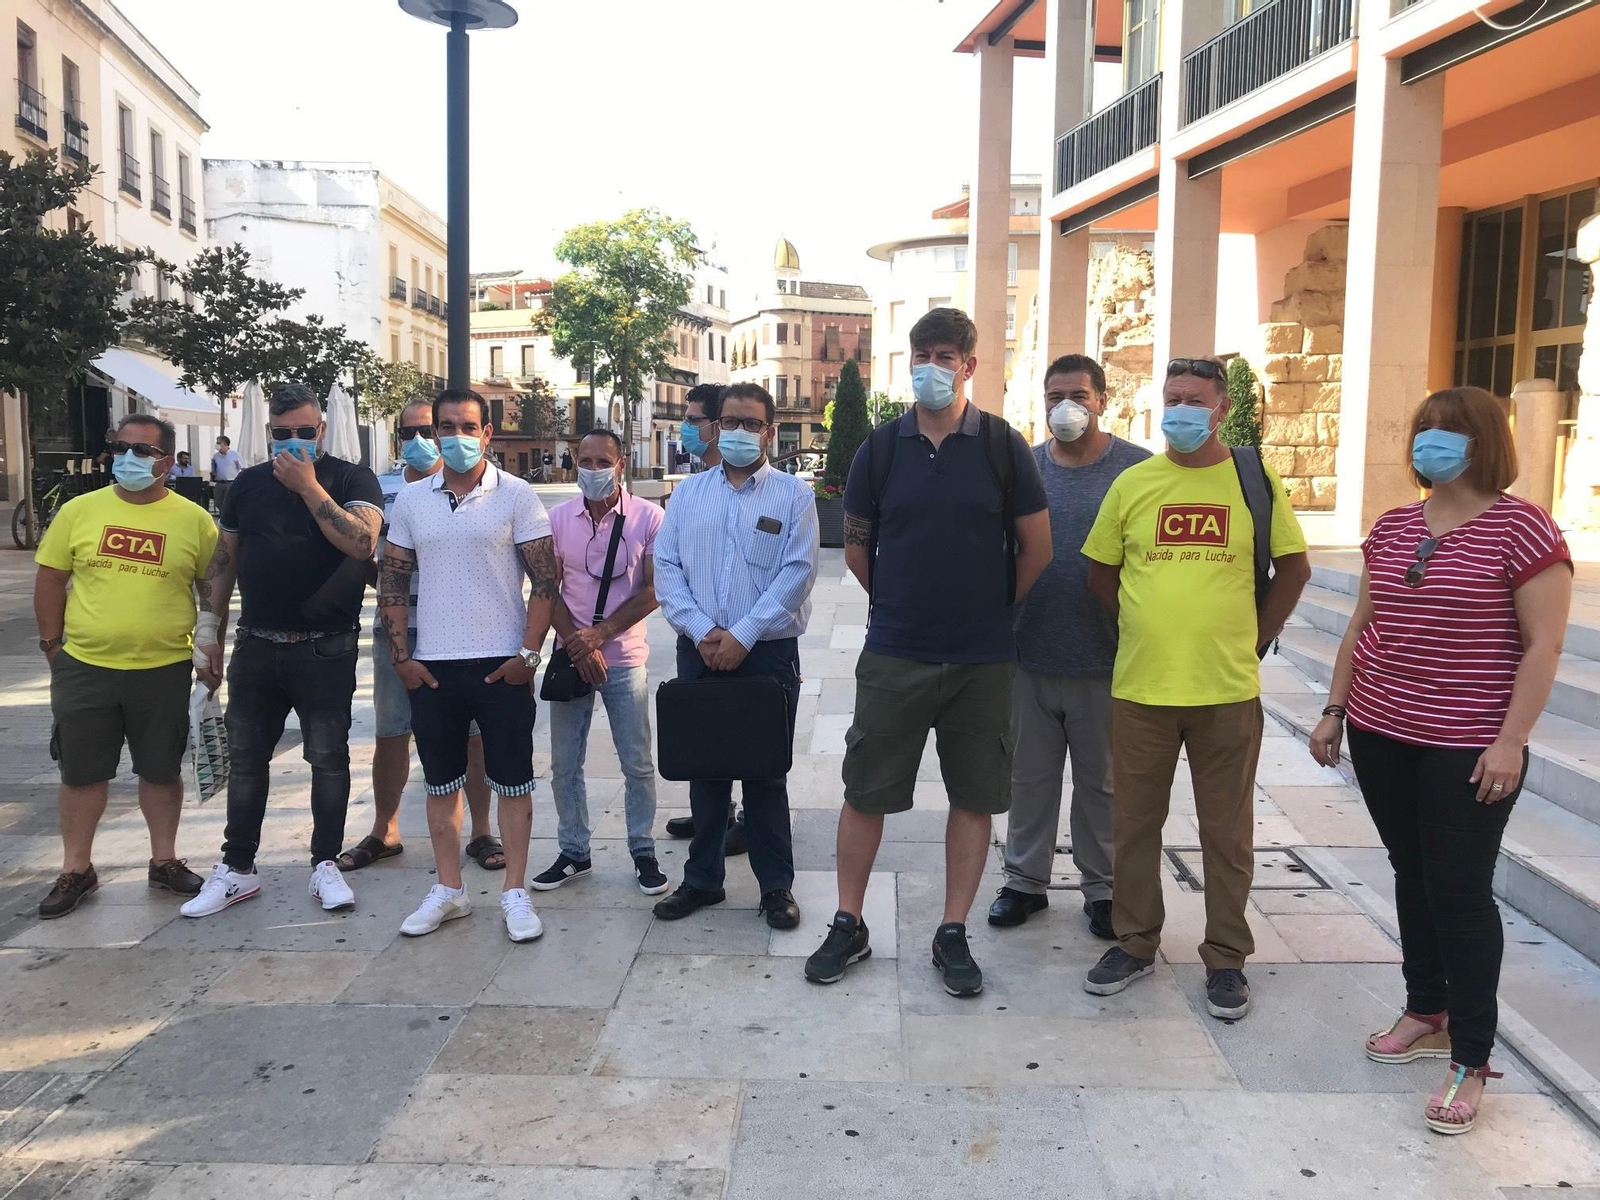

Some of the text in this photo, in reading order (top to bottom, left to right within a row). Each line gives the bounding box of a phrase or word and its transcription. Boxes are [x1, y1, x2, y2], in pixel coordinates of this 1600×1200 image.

[1164, 514, 1221, 537] CTA
[106, 533, 157, 556] CTA
[1145, 549, 1236, 563] Nacida para Luchar
[86, 558, 170, 579] Nacida para Luchar
